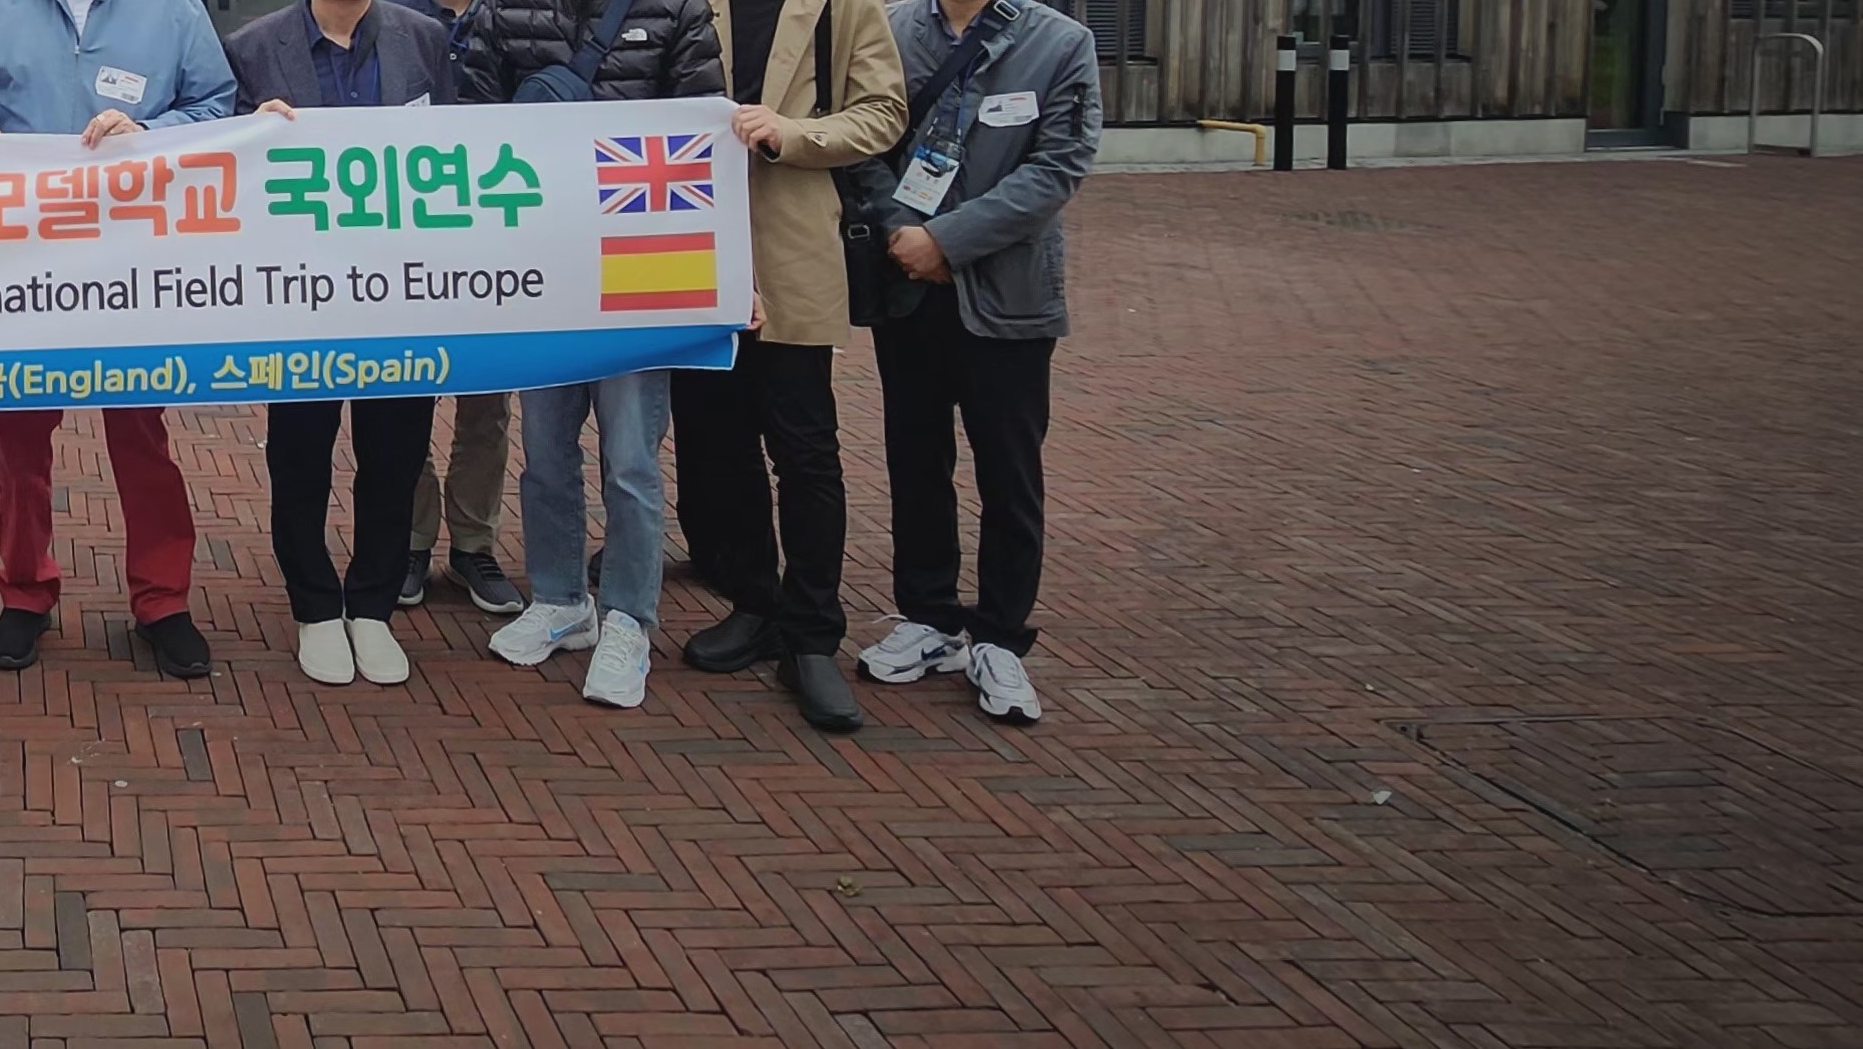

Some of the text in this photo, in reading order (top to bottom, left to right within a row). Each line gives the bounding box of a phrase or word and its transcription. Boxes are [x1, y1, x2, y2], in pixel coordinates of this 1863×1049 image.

[265, 142, 544, 232] 국외연수
[153, 264, 242, 309] Field
[256, 264, 336, 311] Trip
[347, 267, 389, 303] to
[404, 261, 545, 306] Europe
[211, 346, 450, 392] 스페인(Spain)
